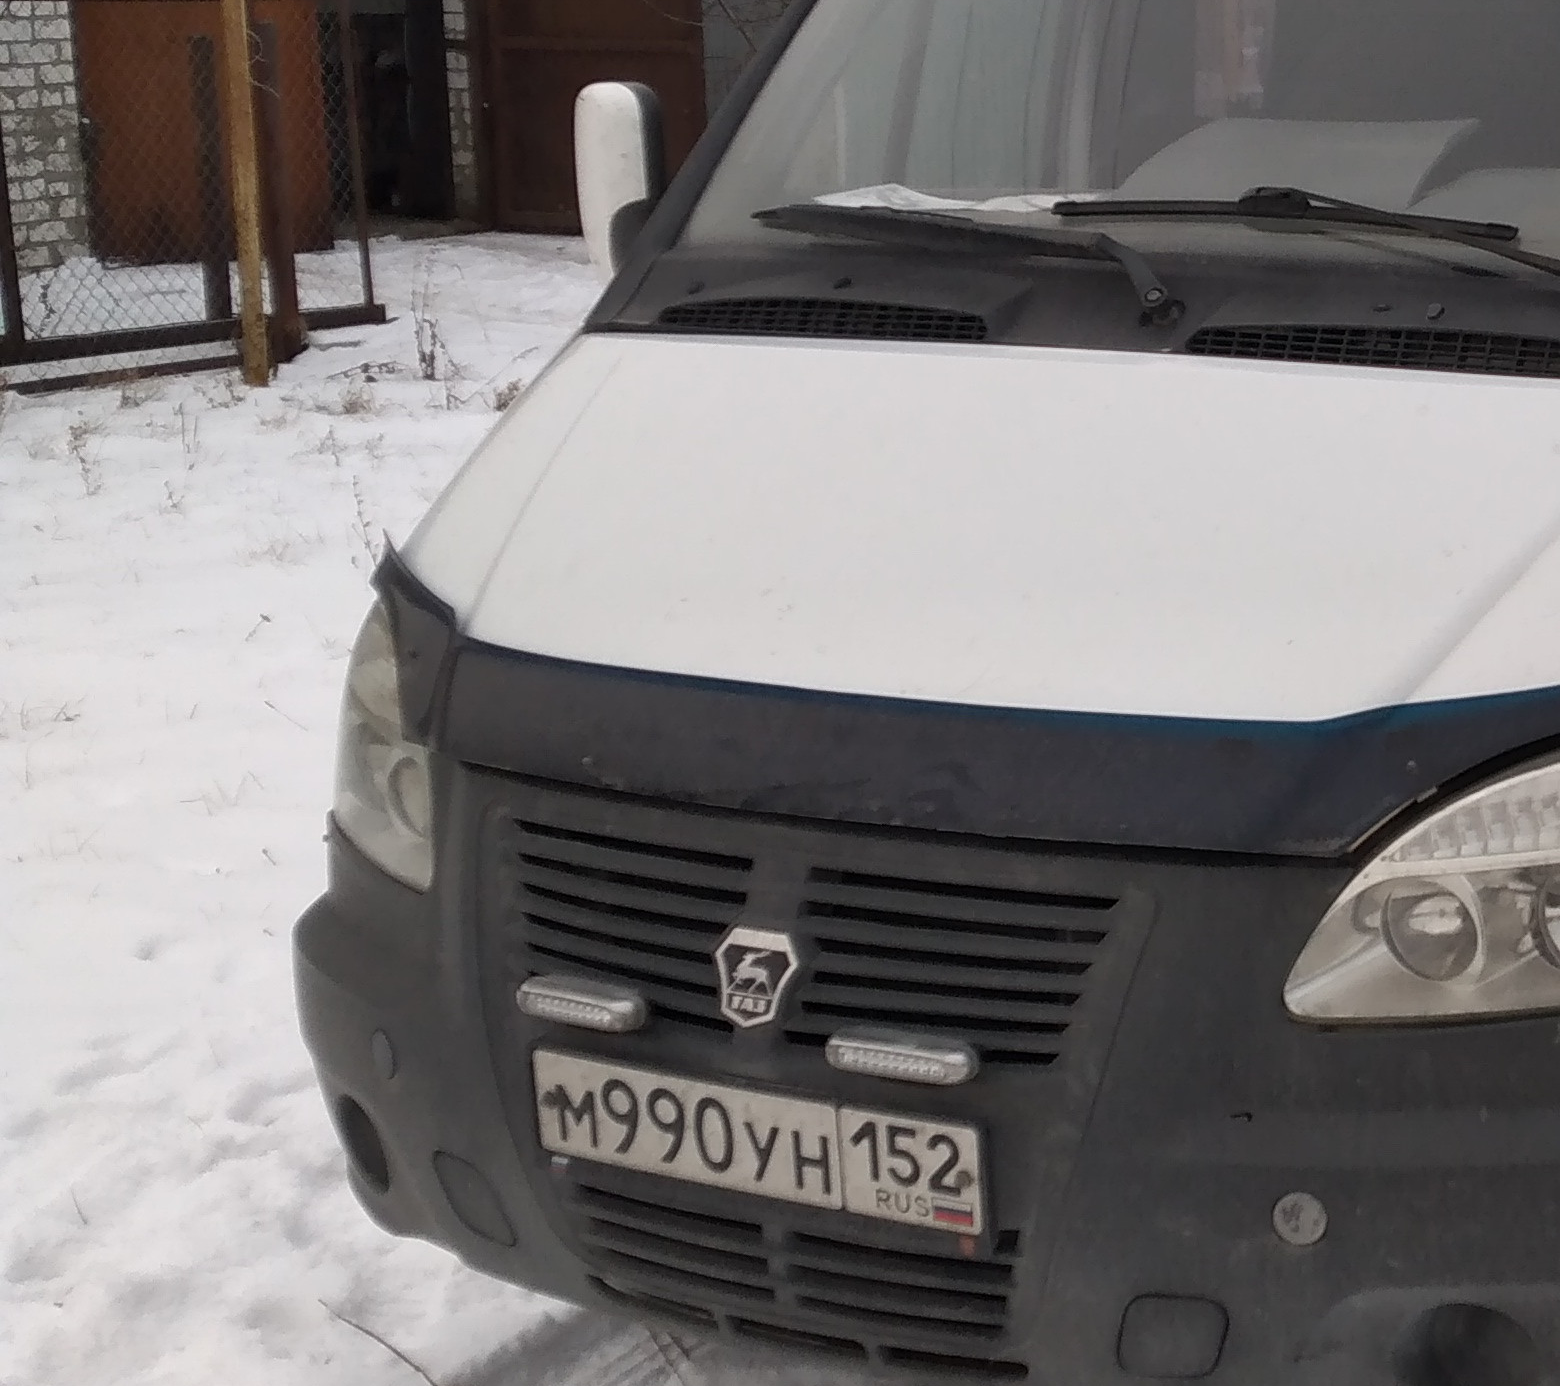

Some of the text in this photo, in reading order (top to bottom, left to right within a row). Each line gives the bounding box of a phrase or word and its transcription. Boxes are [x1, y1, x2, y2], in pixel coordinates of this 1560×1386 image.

[730, 995, 768, 1014] ГАЗ
[554, 1079, 962, 1197] М990УН 152
[875, 1188, 930, 1218] RUS
